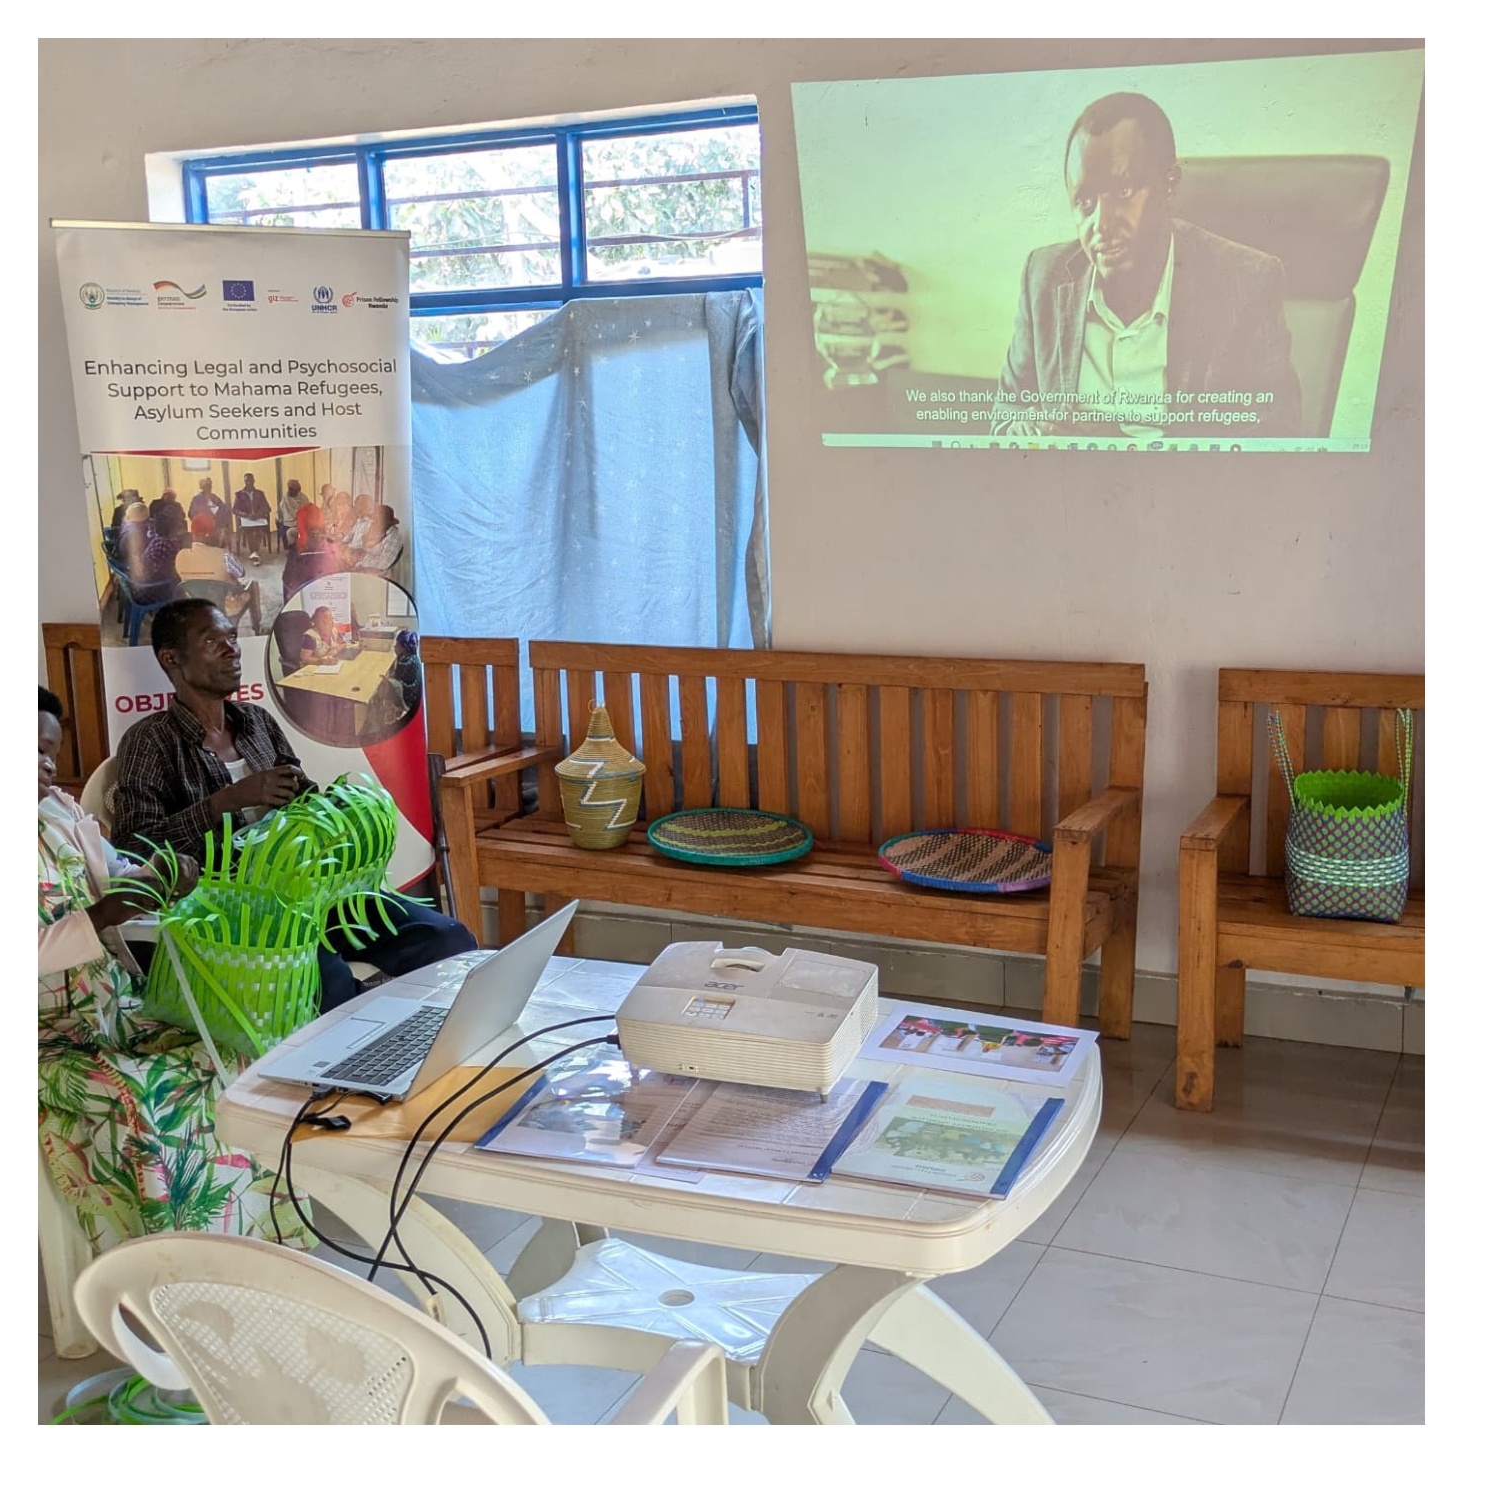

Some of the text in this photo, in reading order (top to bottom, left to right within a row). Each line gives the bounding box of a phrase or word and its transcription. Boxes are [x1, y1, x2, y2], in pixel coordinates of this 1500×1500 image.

[311, 304, 338, 312] UNHCR
[84, 358, 397, 378] Enhancing Legal and Psychosocial
[108, 380, 383, 400] Support to Mahama Refugees,
[906, 389, 1274, 405] We also thank the Government of Rwanda for creating an
[134, 402, 362, 423] Asylum Seekers and Host
[916, 408, 1261, 424] enabling environment for partners to support refugees,
[196, 424, 317, 440] Communities
[704, 981, 745, 990] acer
